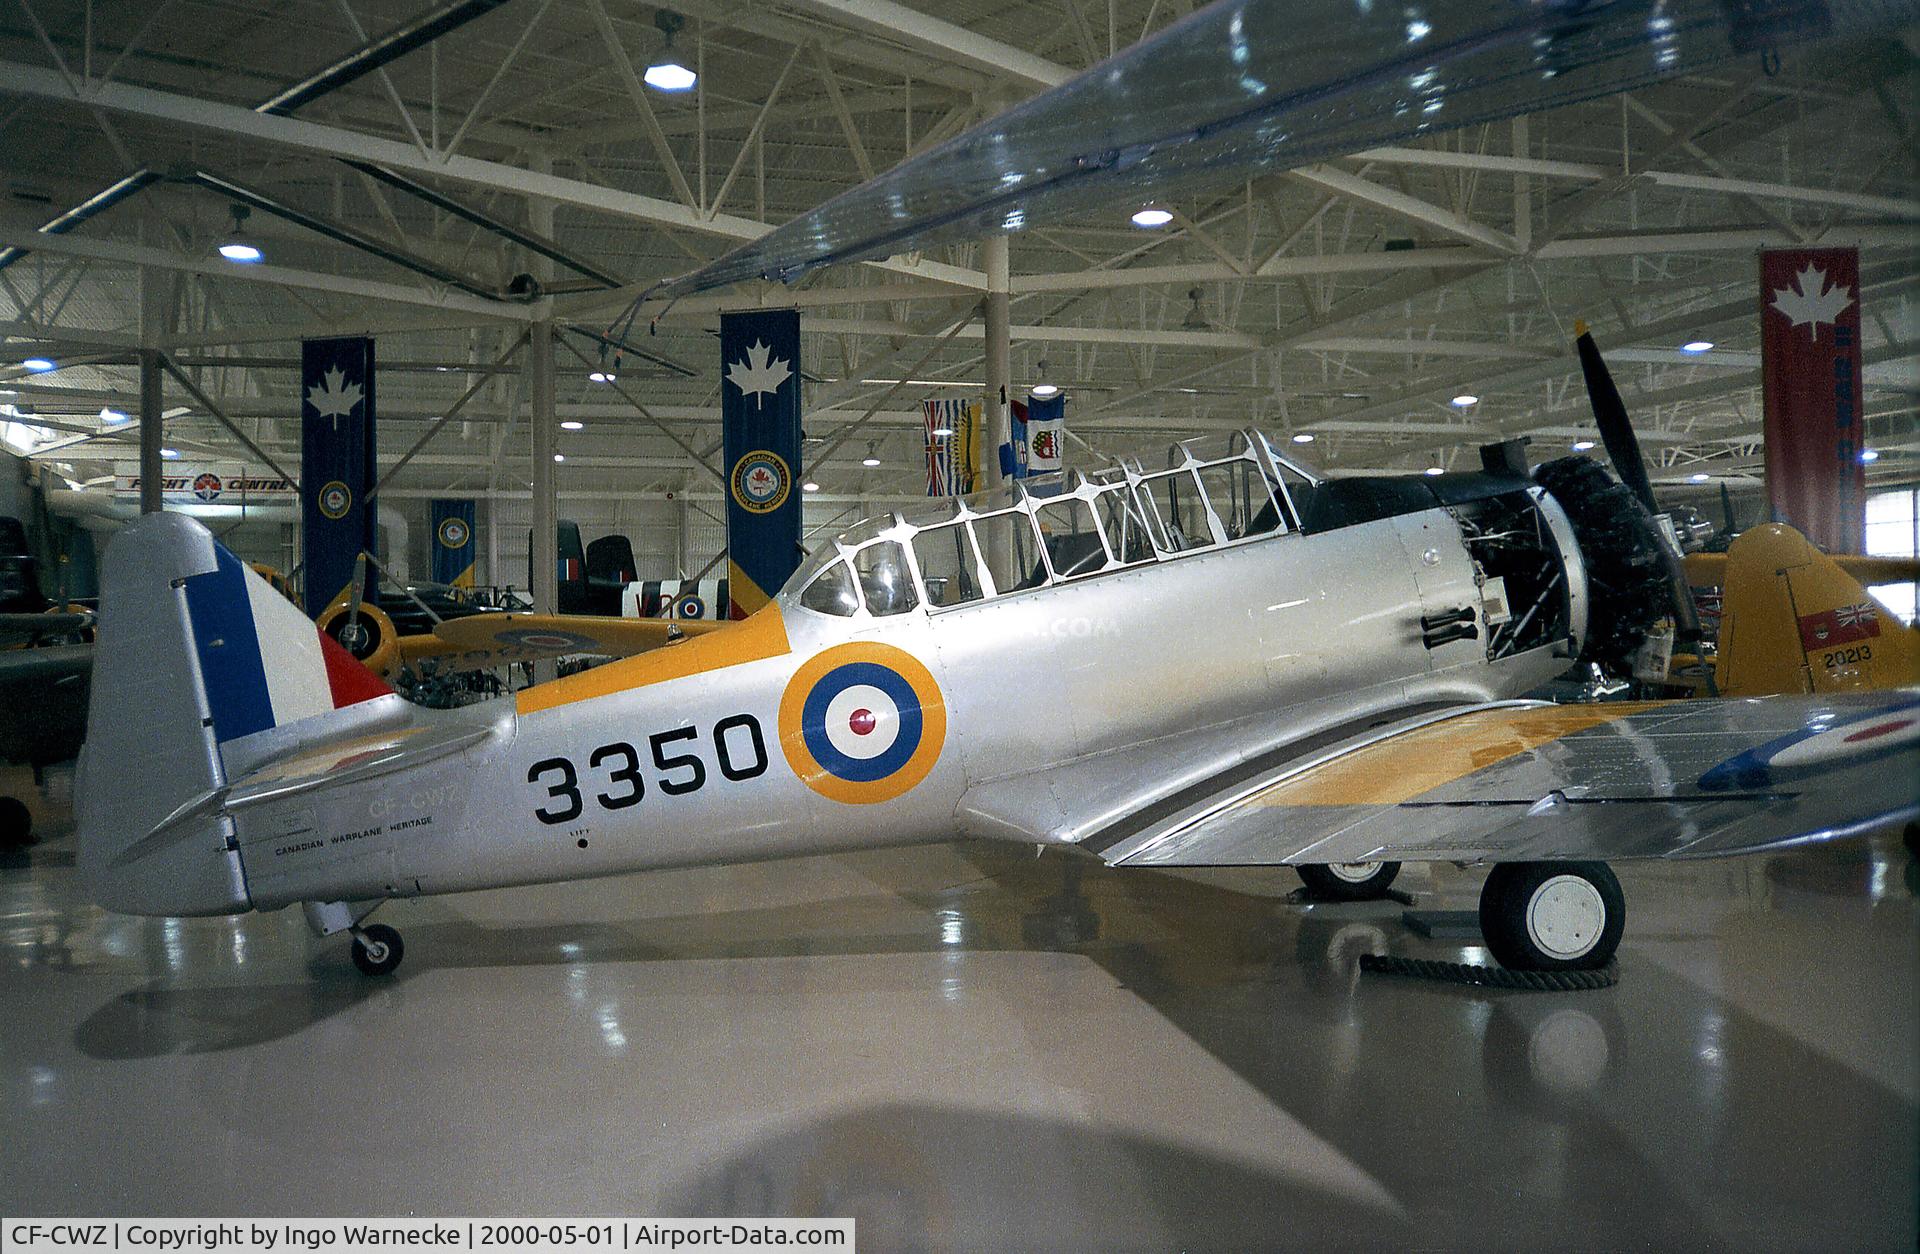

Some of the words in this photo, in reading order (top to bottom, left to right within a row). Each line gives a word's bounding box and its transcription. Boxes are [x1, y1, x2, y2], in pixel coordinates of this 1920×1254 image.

[1824, 645, 1872, 668] 20213
[527, 713, 769, 825] 3350
[275, 840, 324, 857] CANADIAN
[331, 826, 383, 845] WARPLANE
[389, 815, 434, 832] HERITAGE
